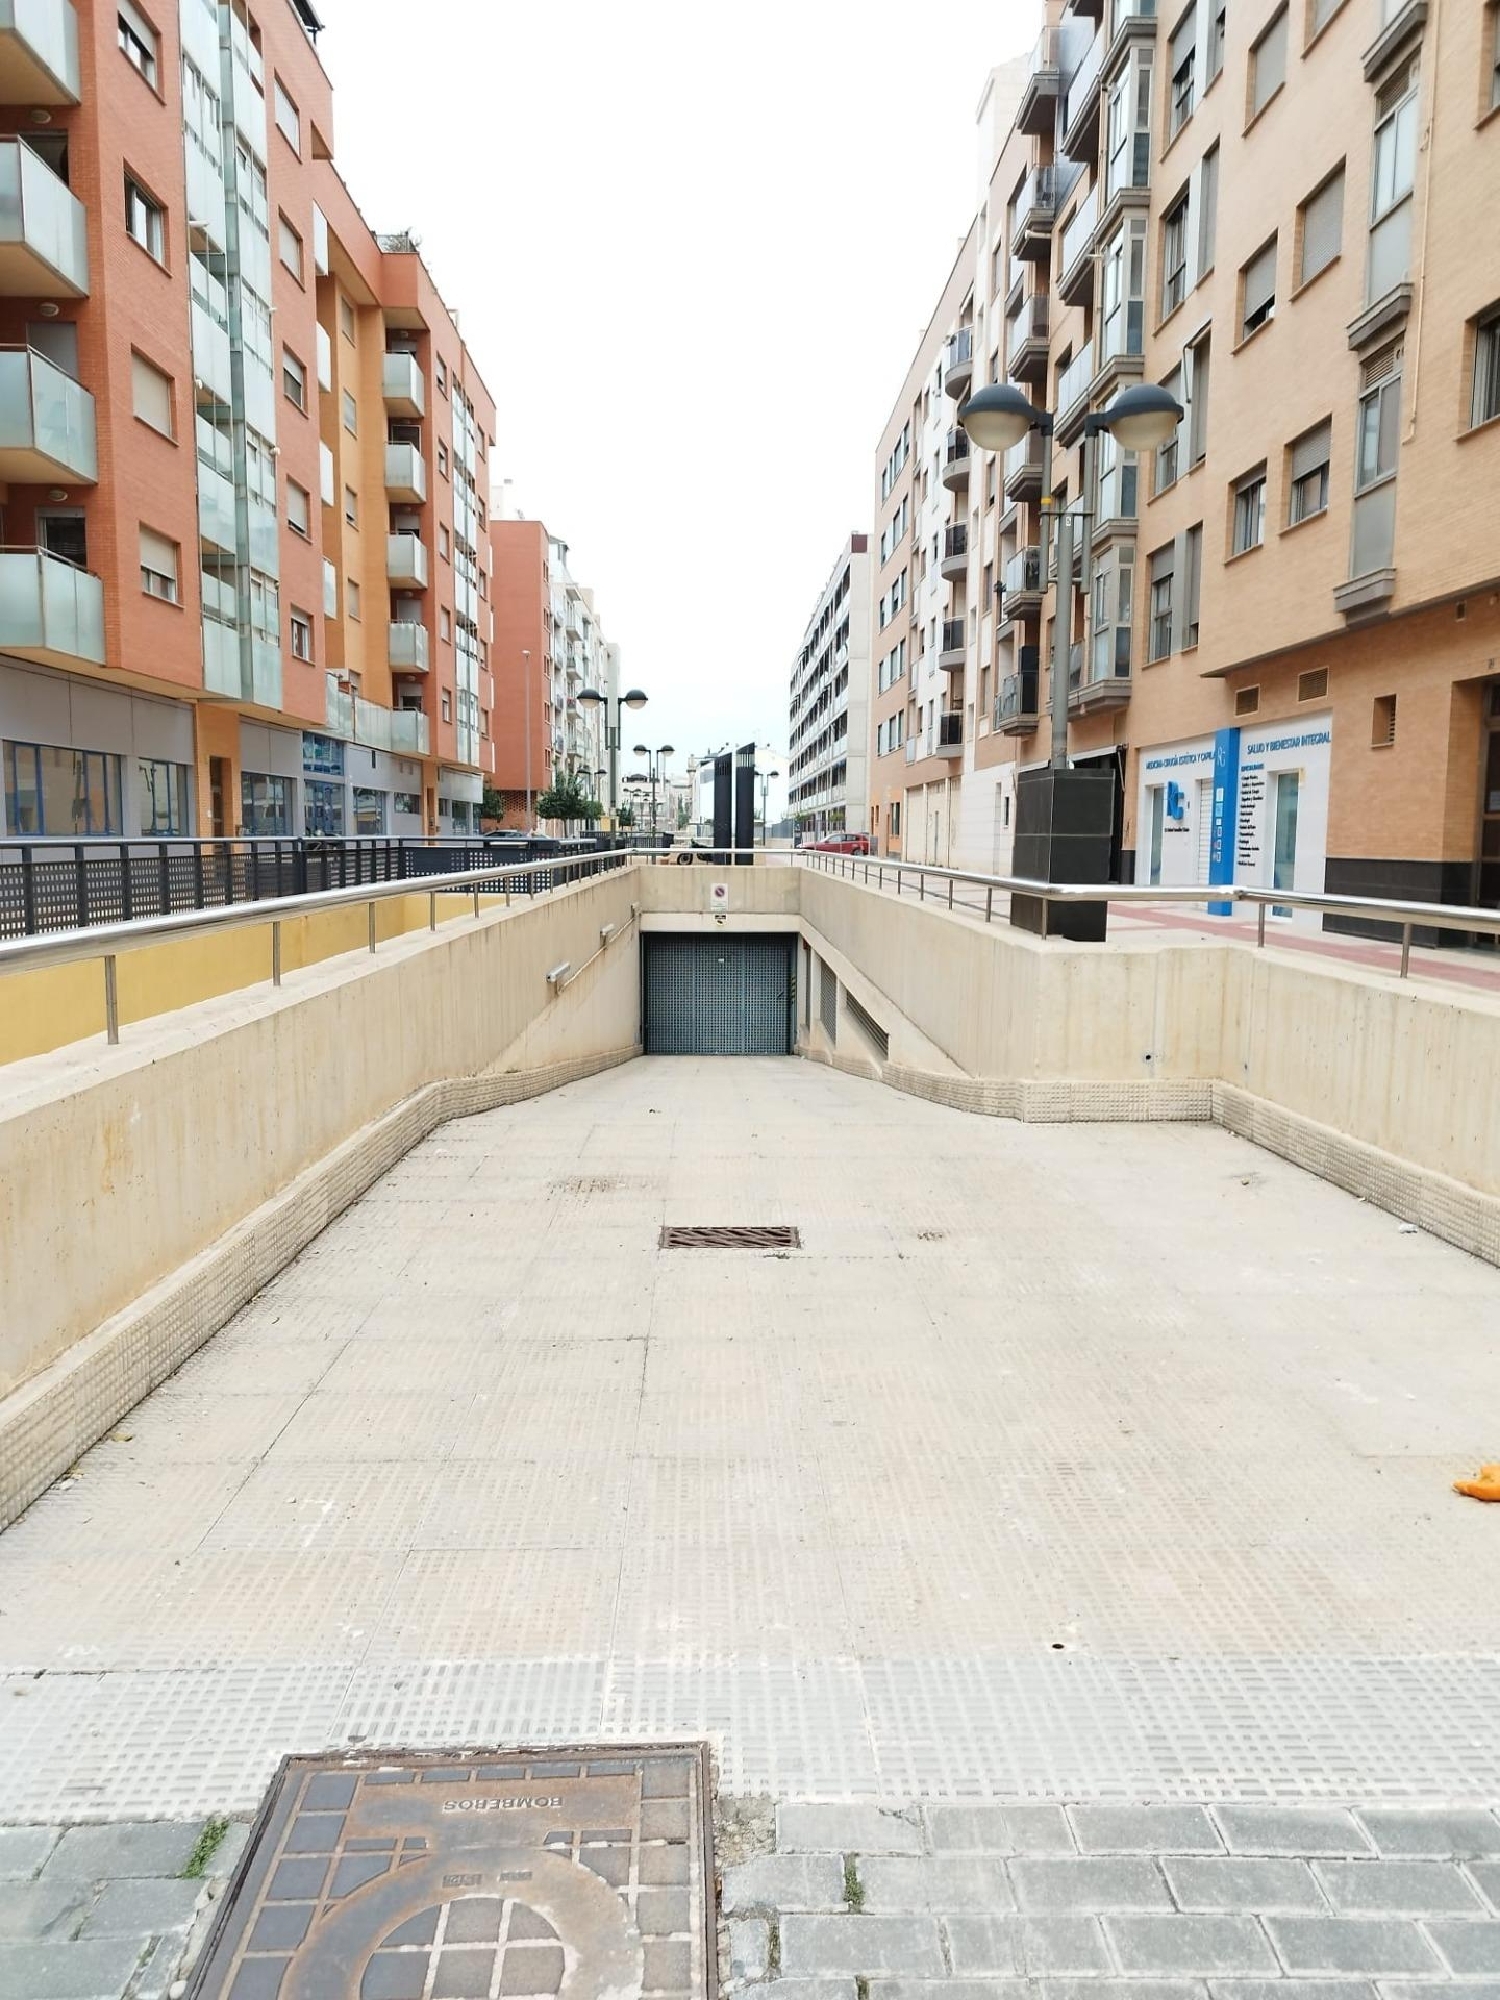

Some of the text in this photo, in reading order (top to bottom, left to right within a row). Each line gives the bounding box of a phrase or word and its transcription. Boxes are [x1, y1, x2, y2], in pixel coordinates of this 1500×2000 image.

[1247, 731, 1332, 755] SALUD Y BIENESTAR INTEGRAL
[443, 1796, 564, 1811] BOMBEROS
